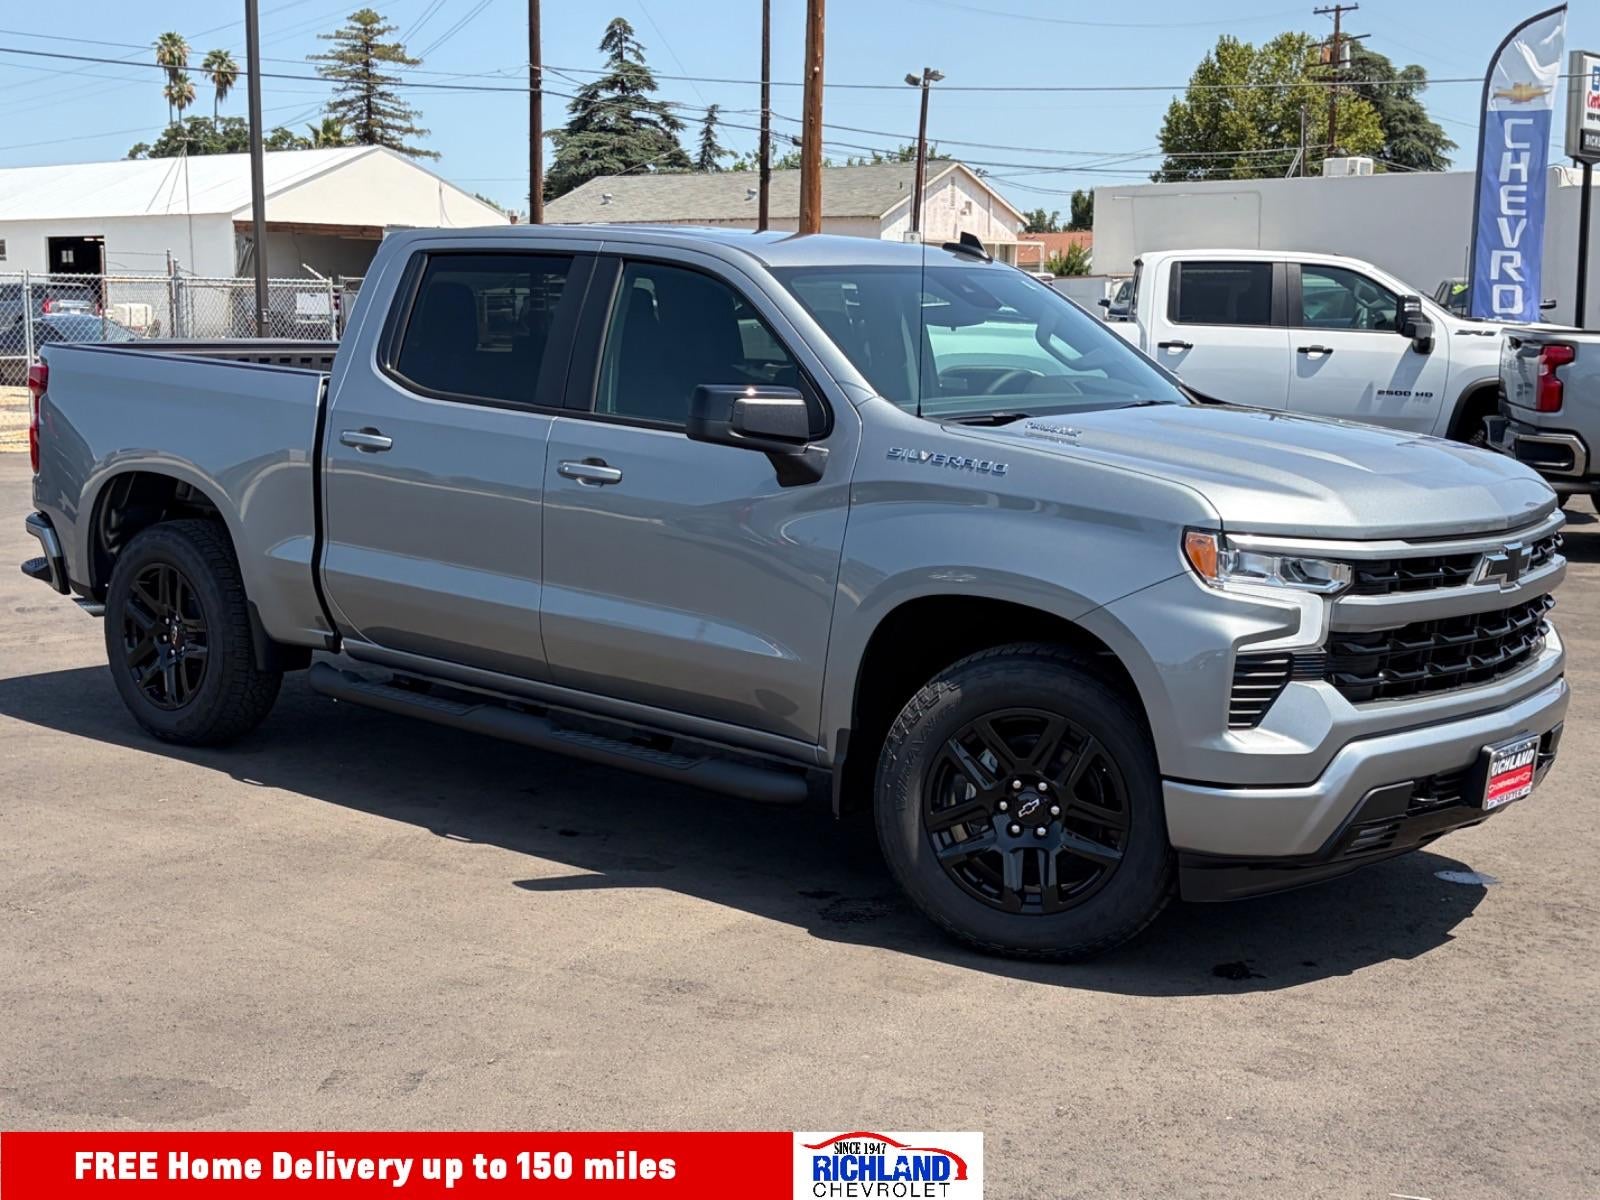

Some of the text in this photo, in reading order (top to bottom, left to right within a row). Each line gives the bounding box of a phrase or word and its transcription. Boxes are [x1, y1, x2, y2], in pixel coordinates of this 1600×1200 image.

[1489, 118, 1534, 323] CHEVRO
[1377, 389, 1411, 397] 2500
[886, 447, 1008, 477] SILVERADO
[1491, 749, 1535, 778] RICHLAND
